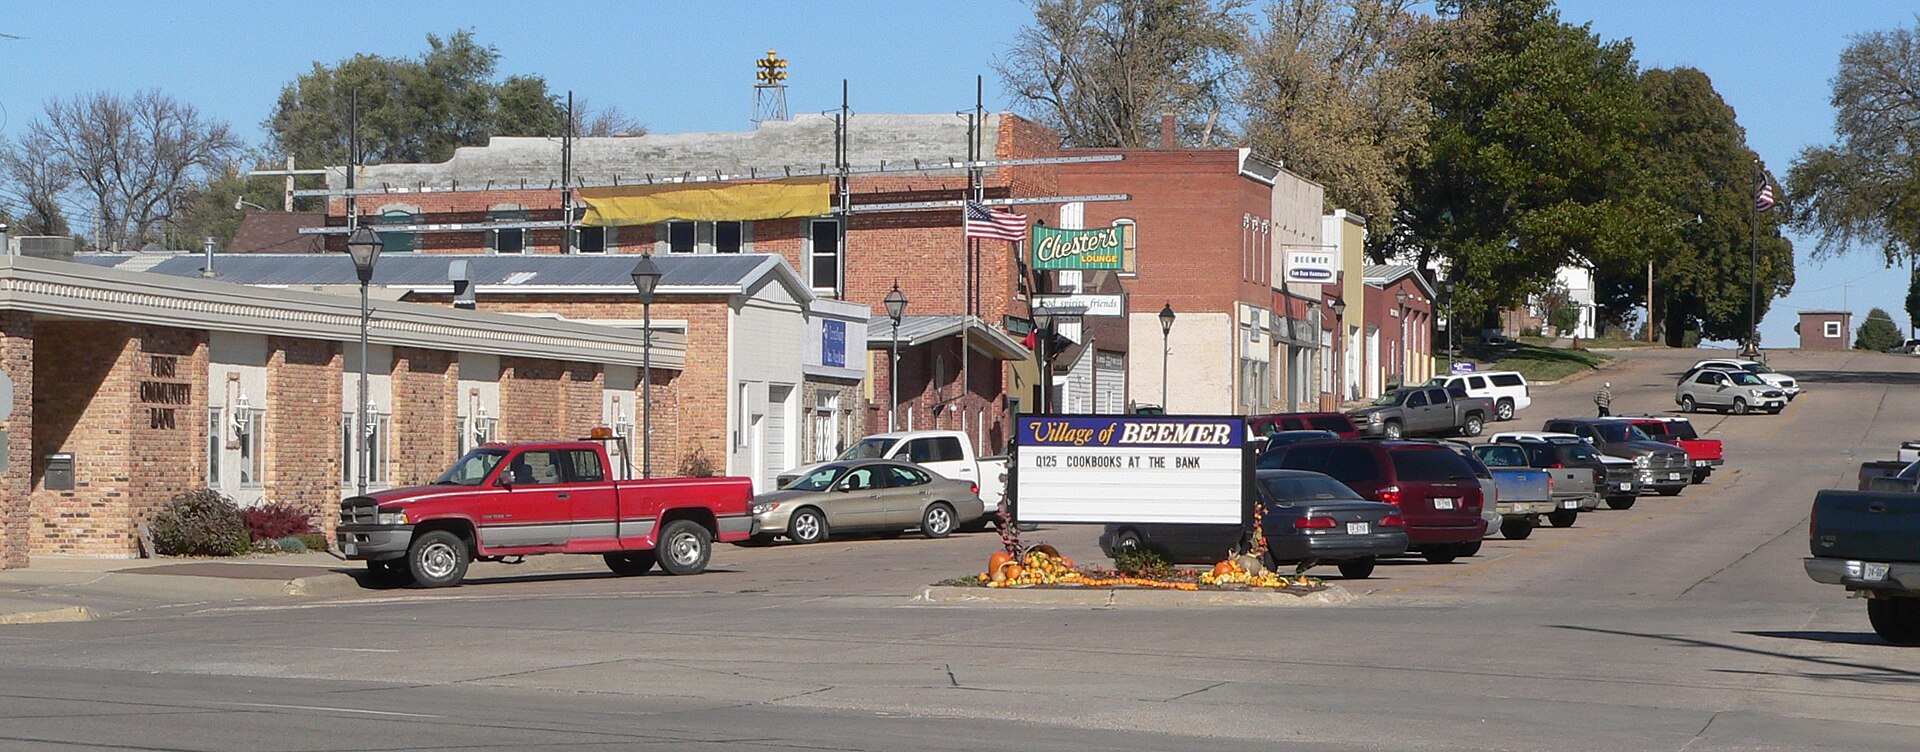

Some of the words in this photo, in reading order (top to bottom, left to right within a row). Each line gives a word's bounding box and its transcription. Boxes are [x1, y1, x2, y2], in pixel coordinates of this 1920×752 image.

[1038, 228, 1119, 262] Chester's
[1080, 255, 1118, 263] LOUNGE
[1089, 298, 1117, 308] friends
[151, 355, 177, 378] FIRST
[151, 407, 176, 430] BANK
[1029, 422, 1093, 445] Village
[1098, 422, 1118, 446] of
[1118, 422, 1232, 445] BEEMER
[1036, 456, 1057, 468] Q125
[1066, 457, 1122, 468] COOKBOOKS
[1128, 457, 1141, 468] AT
[1149, 457, 1166, 468] THE
[1175, 457, 1200, 469] BANK
